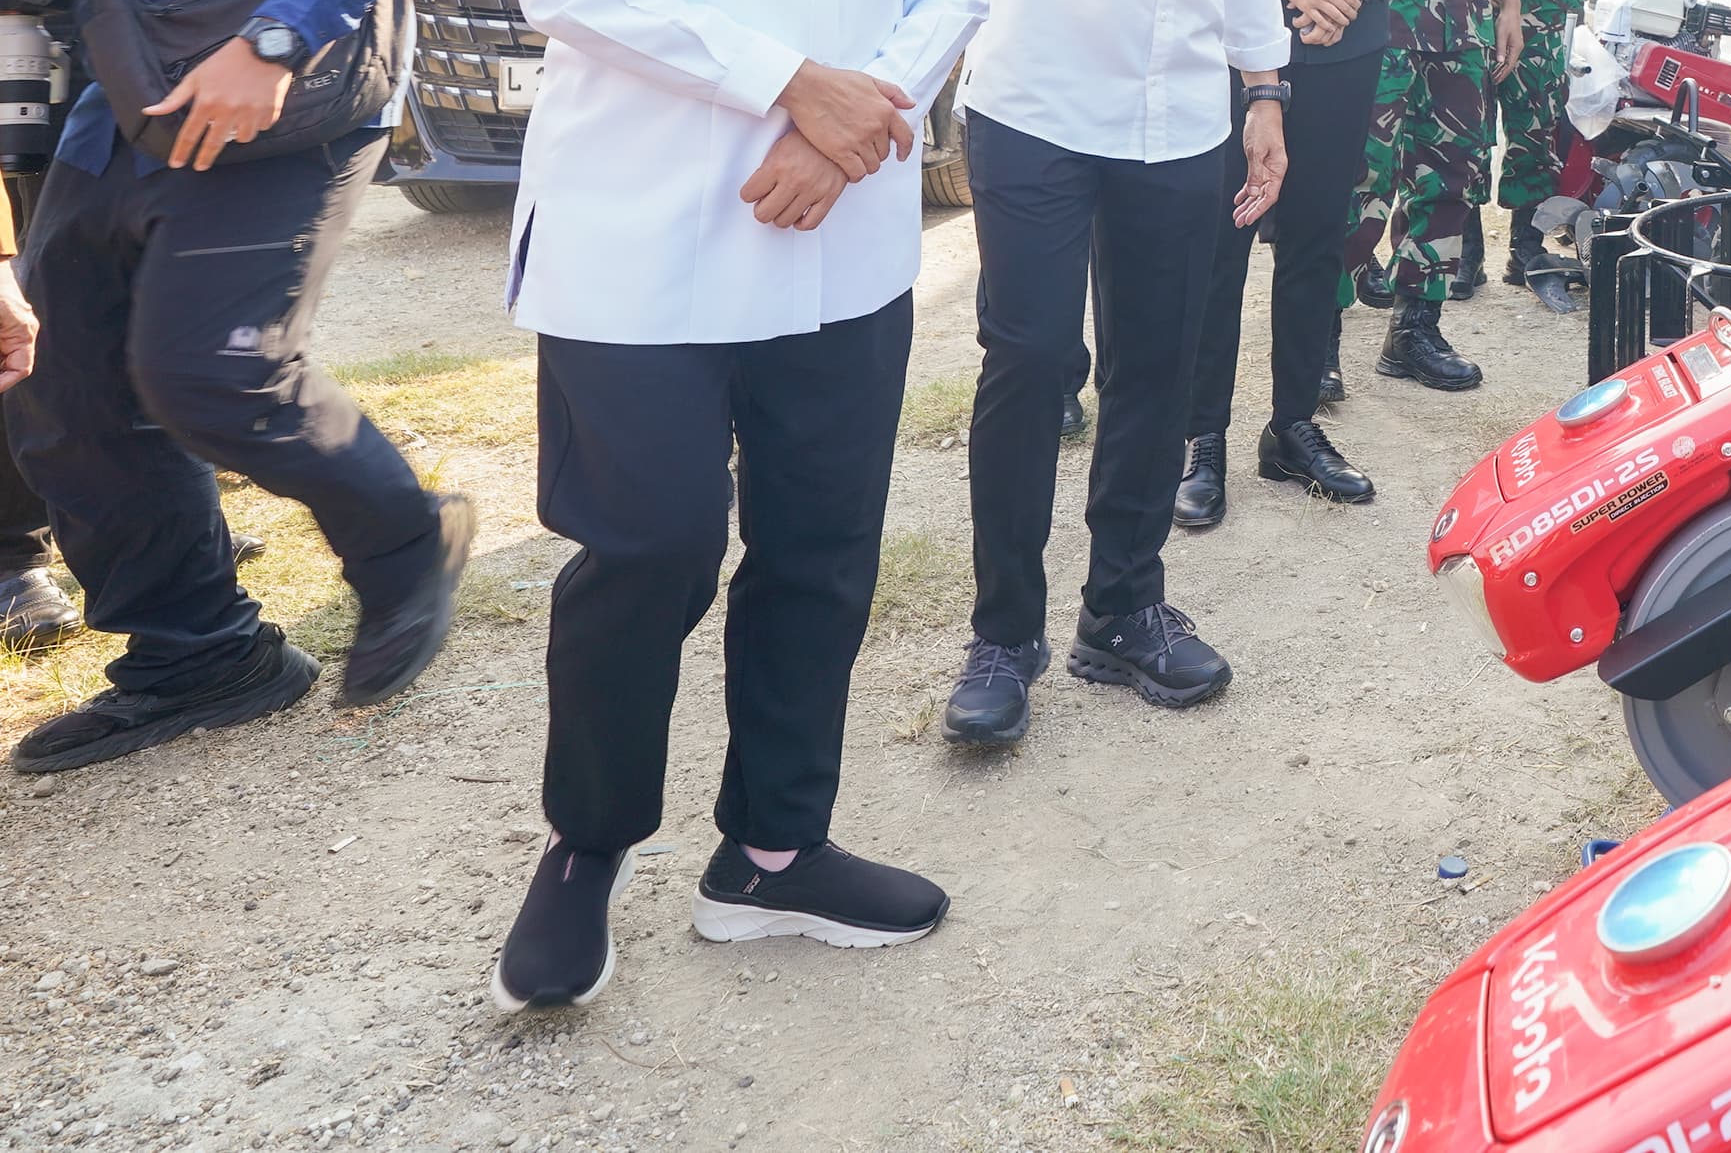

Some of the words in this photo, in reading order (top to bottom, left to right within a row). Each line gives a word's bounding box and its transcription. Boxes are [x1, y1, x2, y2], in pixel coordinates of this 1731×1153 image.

[1510, 432, 1543, 488] Kubota
[1488, 447, 1661, 567] RD85DI-2S
[1571, 500, 1616, 532] SUPER
[1617, 471, 1666, 505] POWER
[1609, 502, 1634, 519] DIRECT
[1510, 933, 1564, 1113] Kubota
